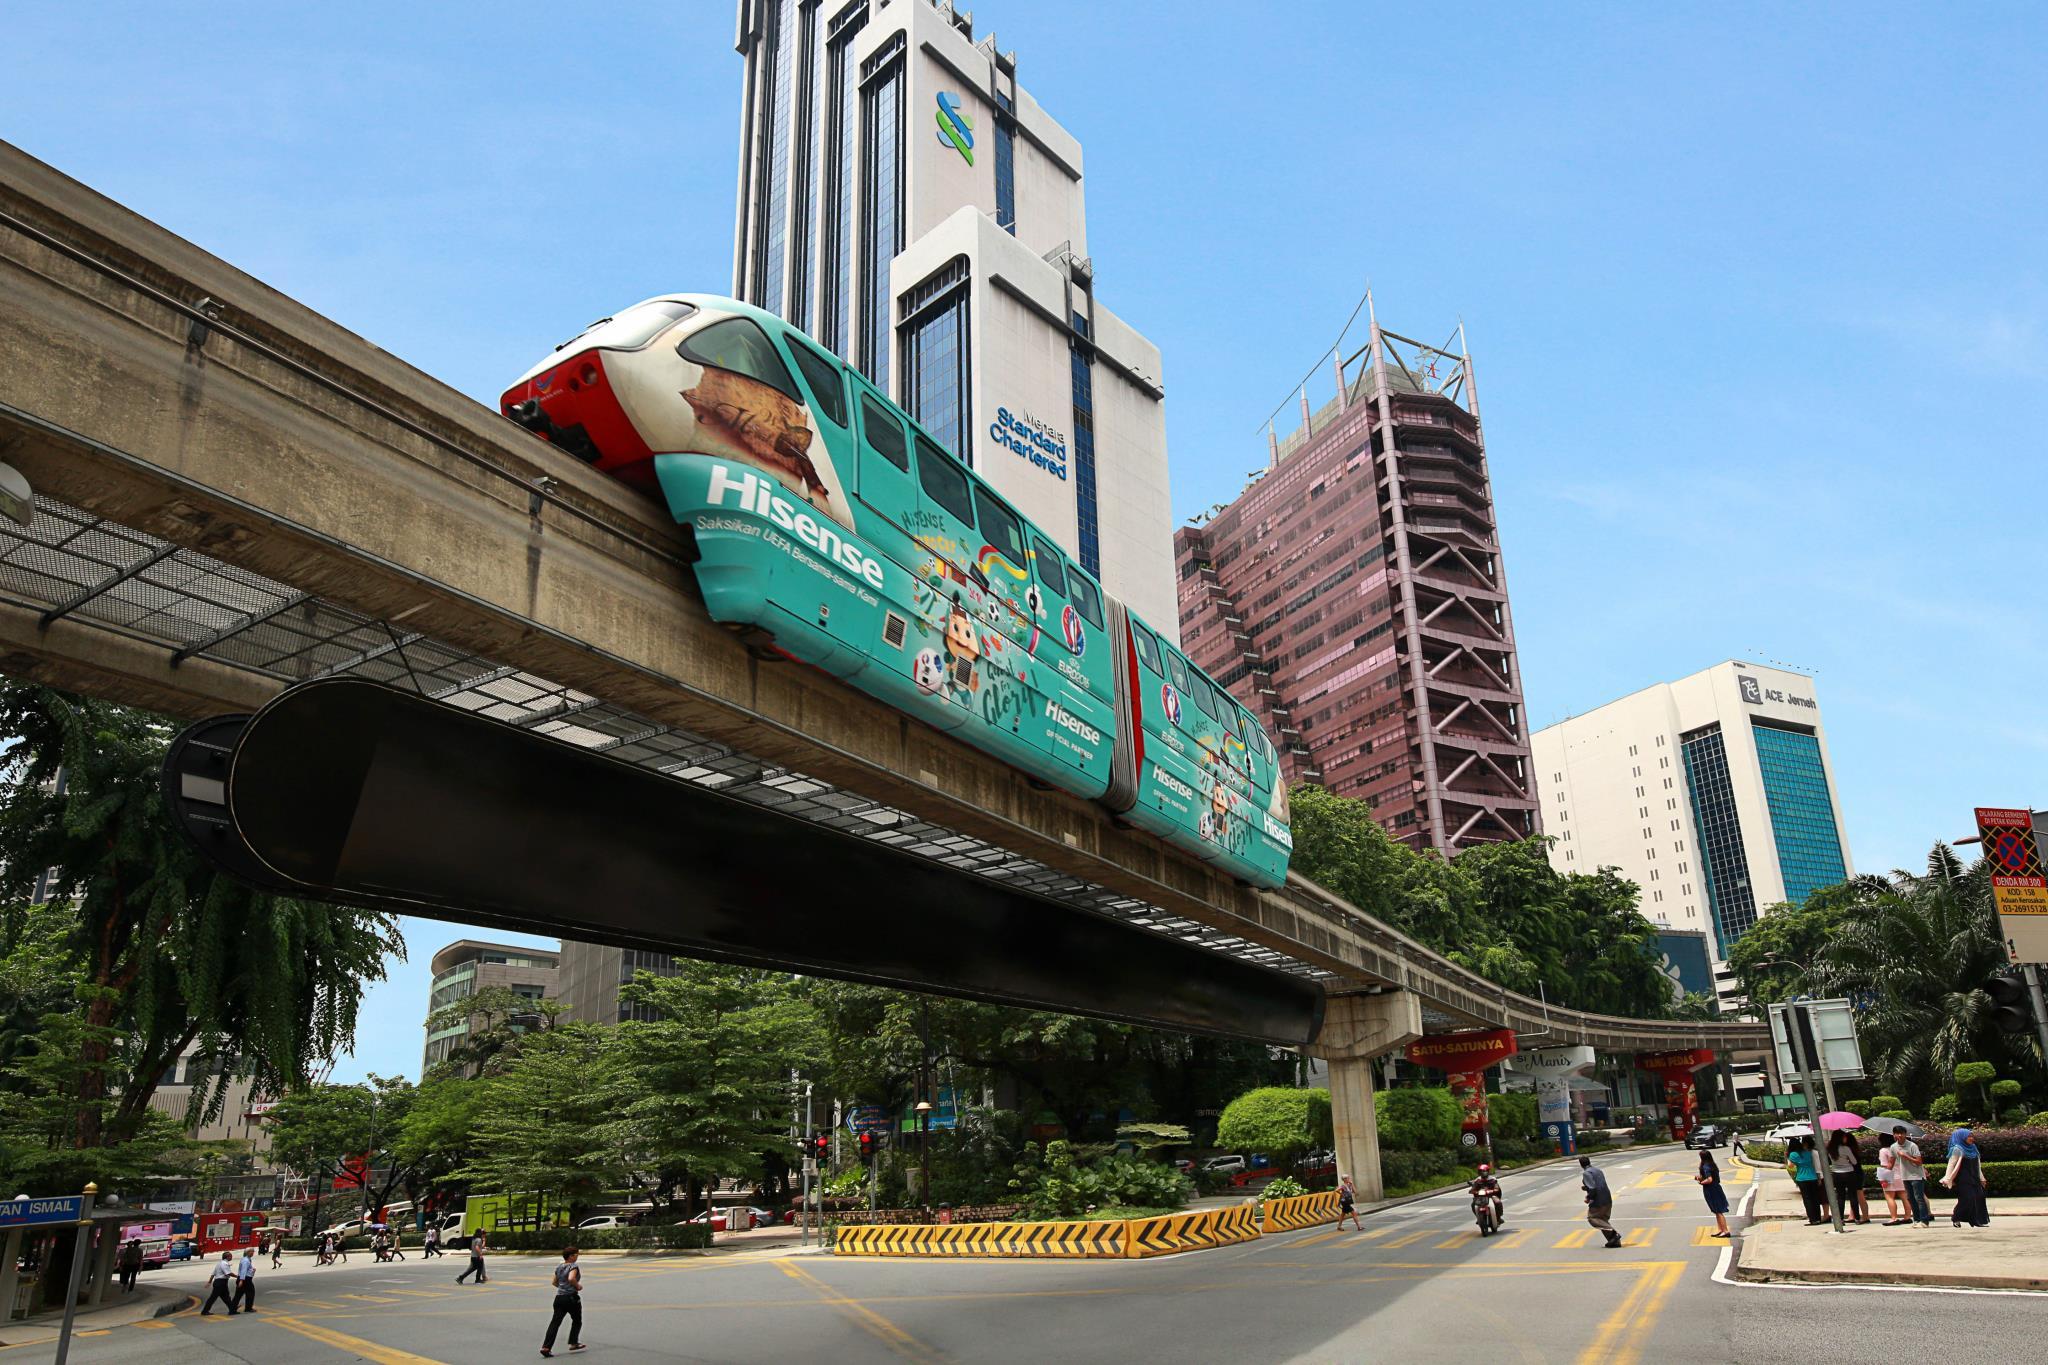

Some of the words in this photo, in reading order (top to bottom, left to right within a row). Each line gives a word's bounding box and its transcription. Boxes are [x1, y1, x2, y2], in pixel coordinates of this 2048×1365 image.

[998, 406, 1066, 461] Standard
[990, 422, 1066, 481] Chartered
[707, 464, 884, 590] Hisense
[696, 515, 761, 537] Saksikan
[763, 528, 791, 555] UEFA
[791, 548, 857, 595] Bersama-sama
[857, 588, 879, 608] Kami
[1765, 688, 1784, 703] ACE
[1787, 694, 1816, 709] Jerneh
[1045, 700, 1100, 746] Hisense
[1070, 743, 1094, 761] PARTNER
[1152, 764, 1193, 801] Hisense
[1978, 810, 2004, 819] DILARANG
[1996, 877, 2018, 887] DENDA
[2018, 877, 2029, 887] RM
[2029, 878, 2041, 887] 300
[2006, 888, 2023, 896] KOD:
[2024, 888, 2036, 896] 158
[1412, 1039, 1505, 1057] SATU-SATUNYA
[1525, 1053, 1573, 1071] Manis
[29, 1199, 75, 1215] ISMAIL
